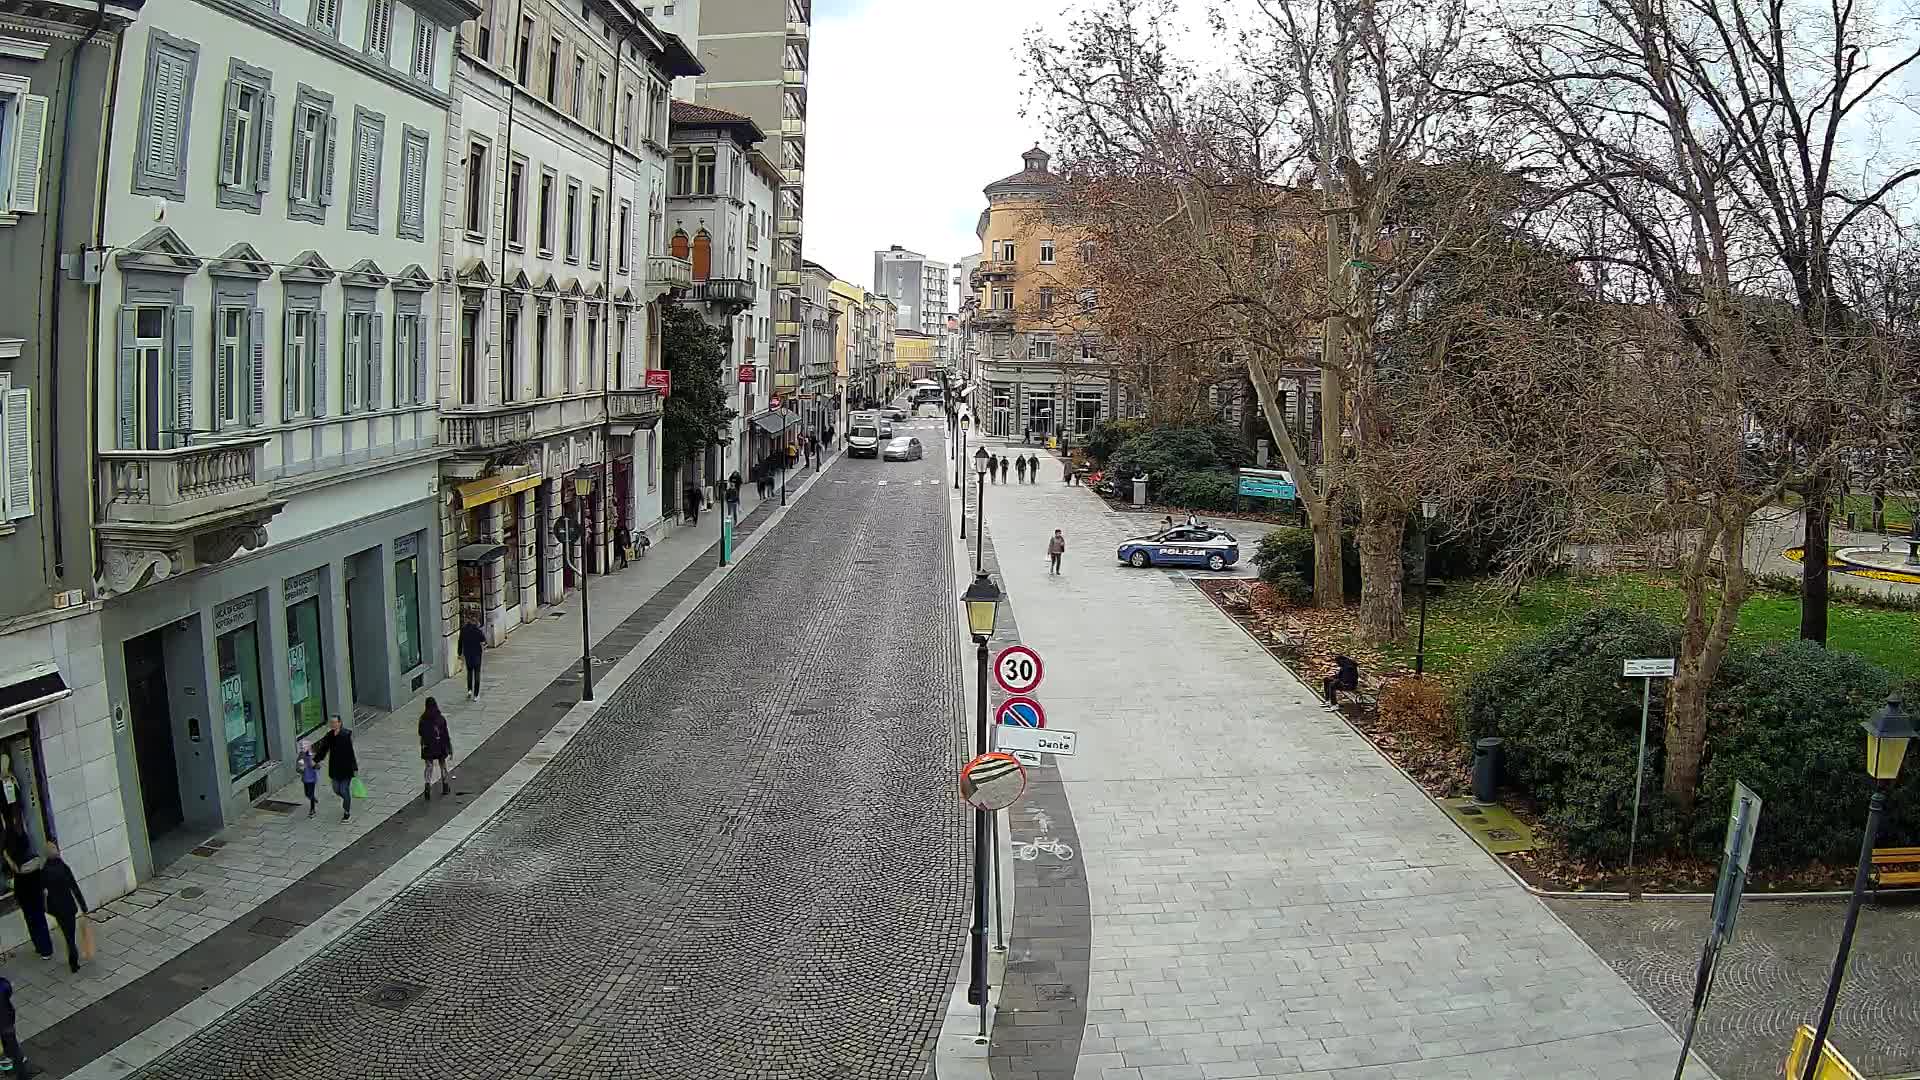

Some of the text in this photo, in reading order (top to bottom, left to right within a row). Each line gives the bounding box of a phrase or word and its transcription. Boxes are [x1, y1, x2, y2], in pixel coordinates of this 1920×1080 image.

[1159, 548, 1206, 556] POLIZIA
[1005, 659, 1033, 681] 30
[222, 678, 240, 700] 130
[1038, 739, 1070, 749] Dante
